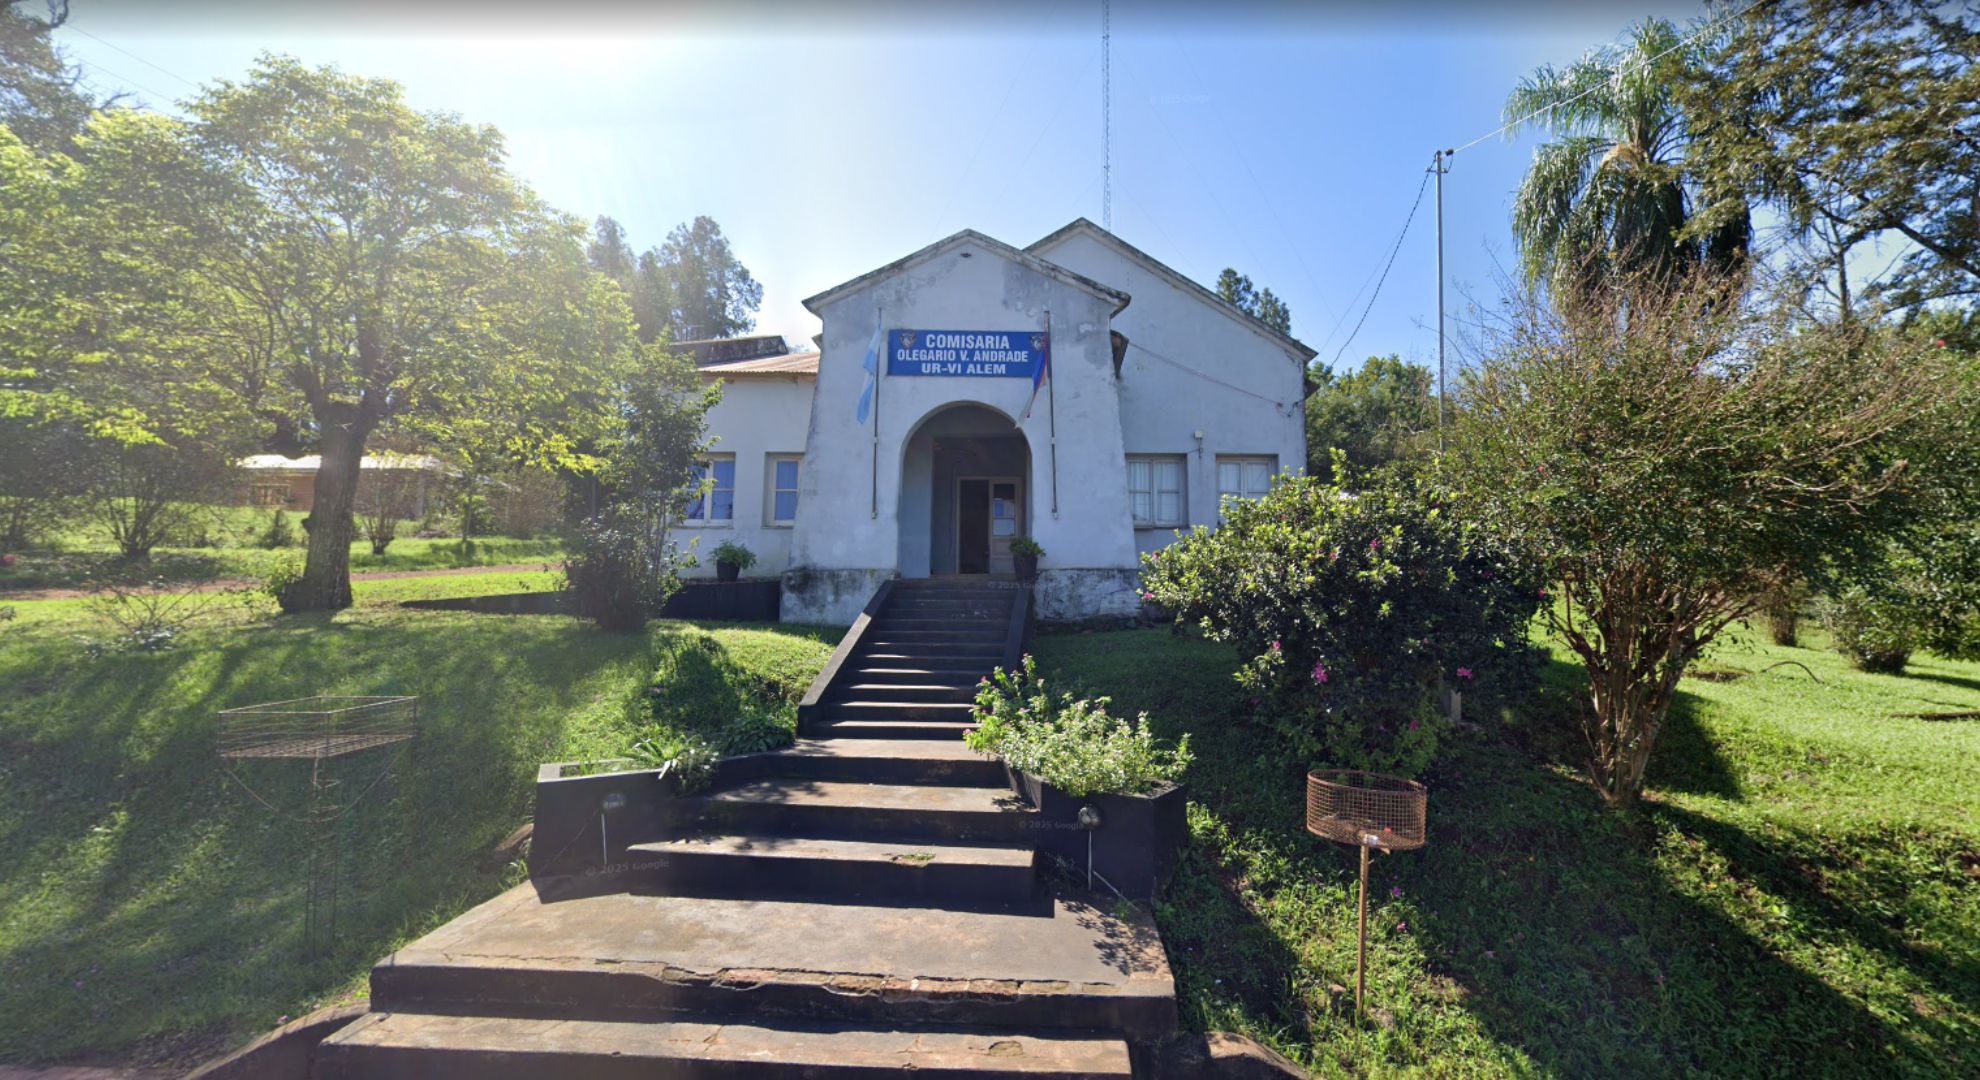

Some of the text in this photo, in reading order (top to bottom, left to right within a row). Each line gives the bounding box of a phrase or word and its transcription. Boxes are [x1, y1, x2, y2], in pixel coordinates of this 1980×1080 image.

[926, 334, 1010, 349] COMISARIA
[897, 349, 1029, 362] OLEGARIO V. ANDRADE
[921, 363, 1006, 375] UR-VI ALEM
